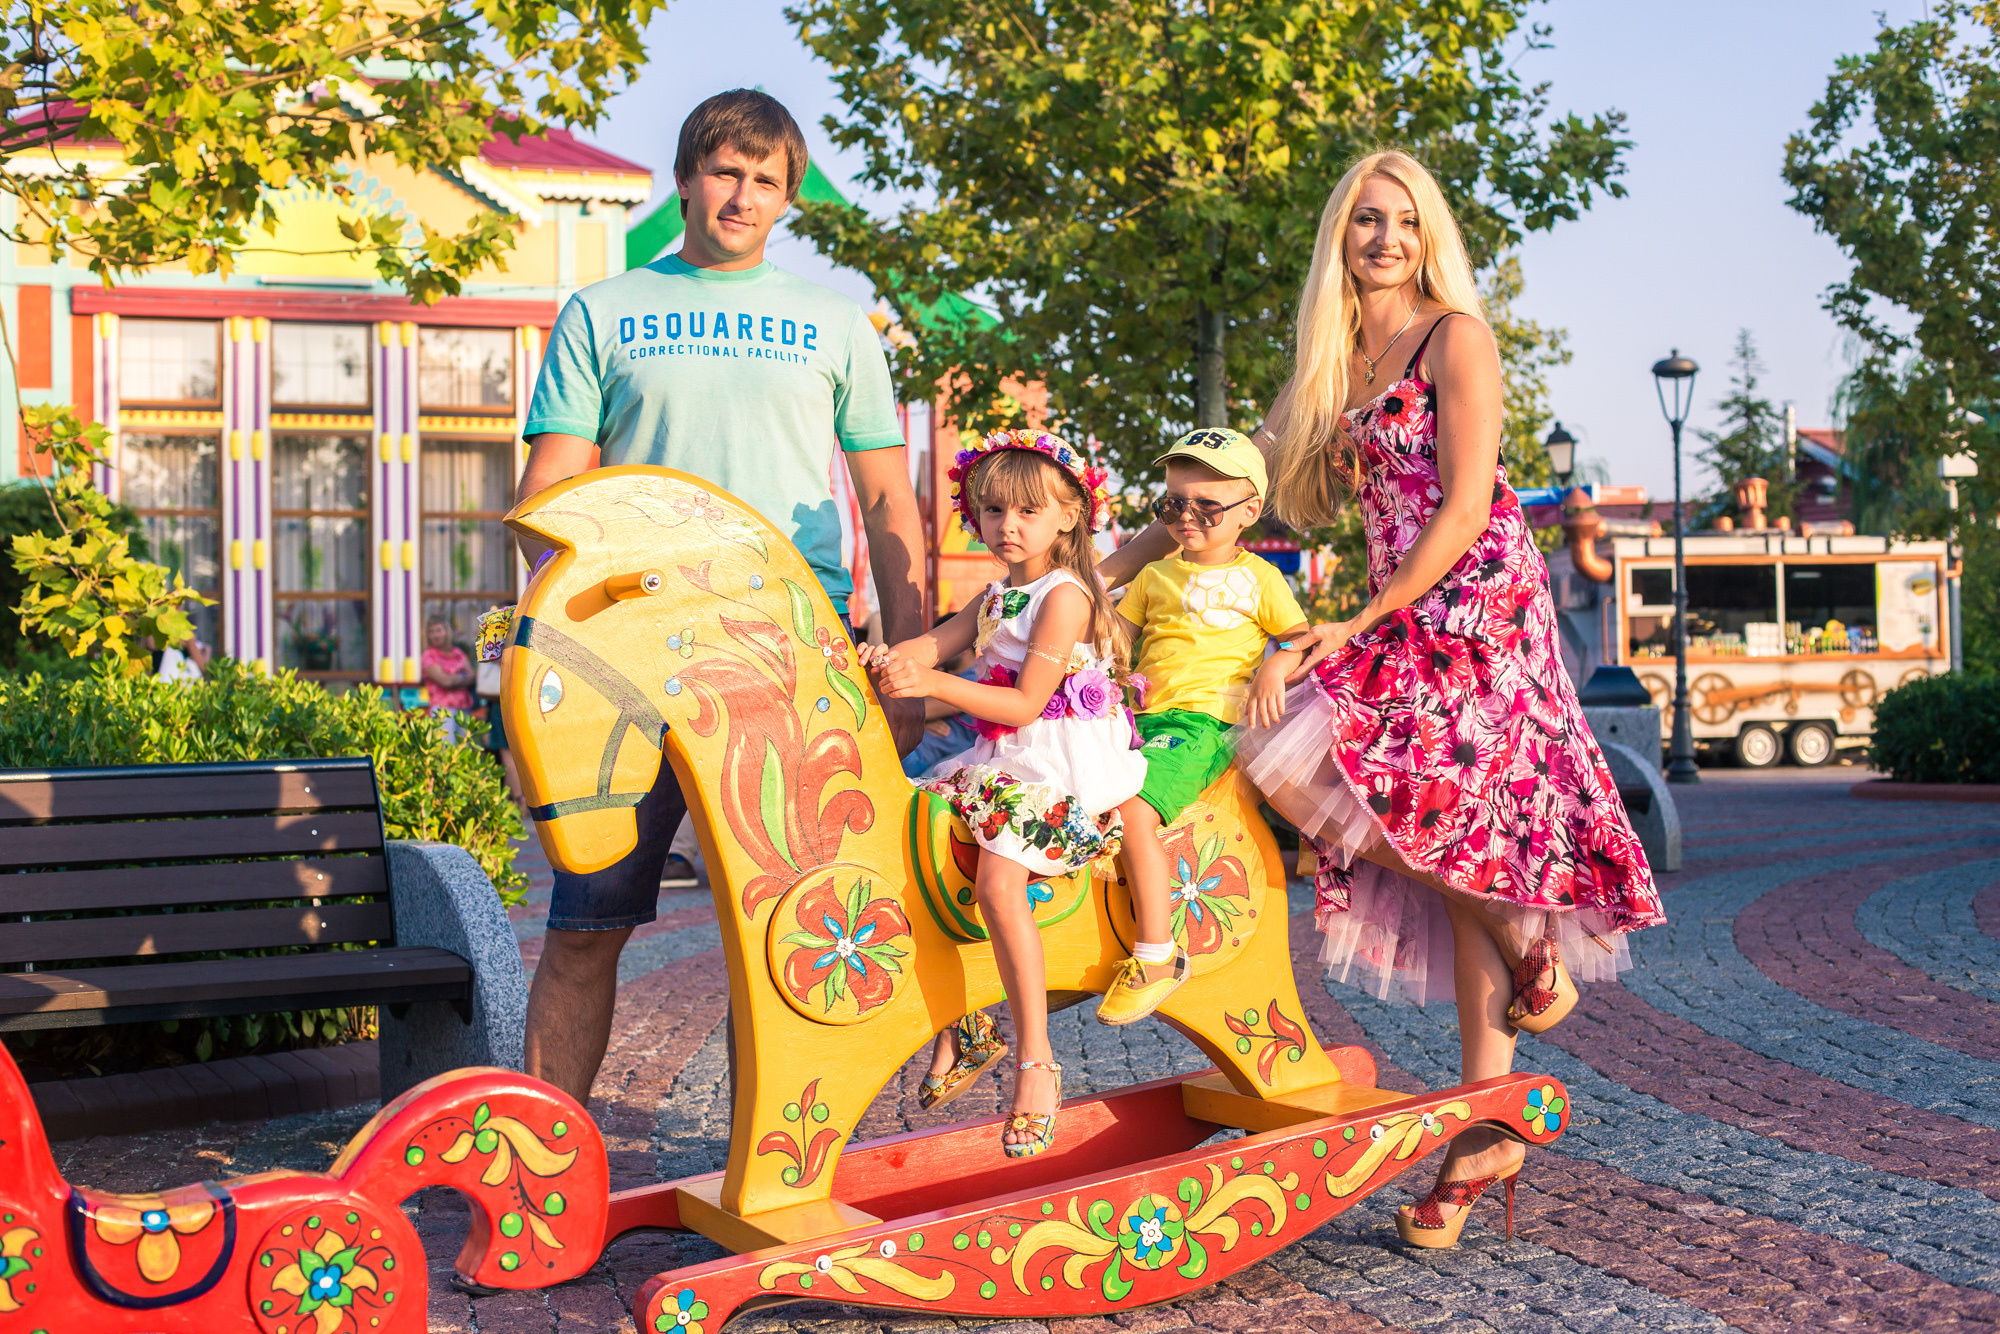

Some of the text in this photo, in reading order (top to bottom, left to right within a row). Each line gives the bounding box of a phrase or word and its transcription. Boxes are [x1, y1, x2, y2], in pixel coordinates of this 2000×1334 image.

[620, 311, 818, 352] DSQUARED2
[630, 344, 808, 366] CORRECTIONAL FACILITY
